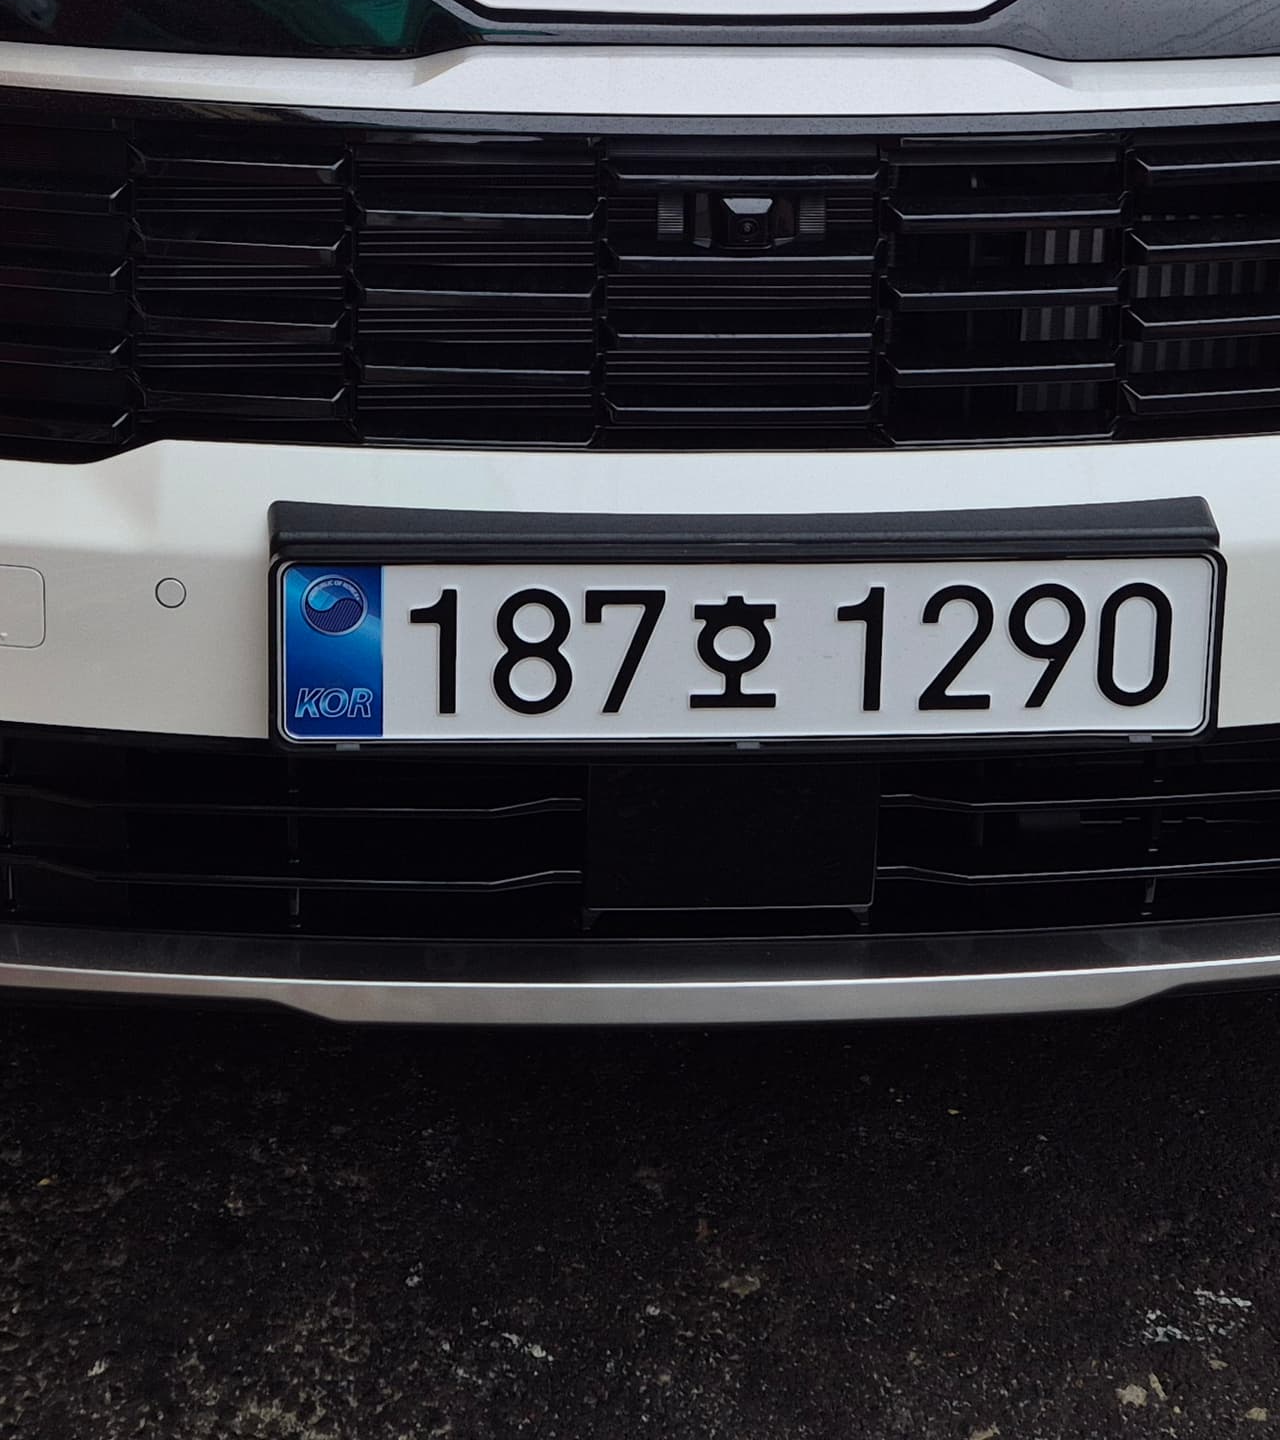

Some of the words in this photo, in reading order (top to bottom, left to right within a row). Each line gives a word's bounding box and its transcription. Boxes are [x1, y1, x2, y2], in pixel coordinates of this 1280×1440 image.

[409, 587, 777, 715] 187호
[835, 581, 1174, 713] 1290
[294, 687, 374, 718] KOR
